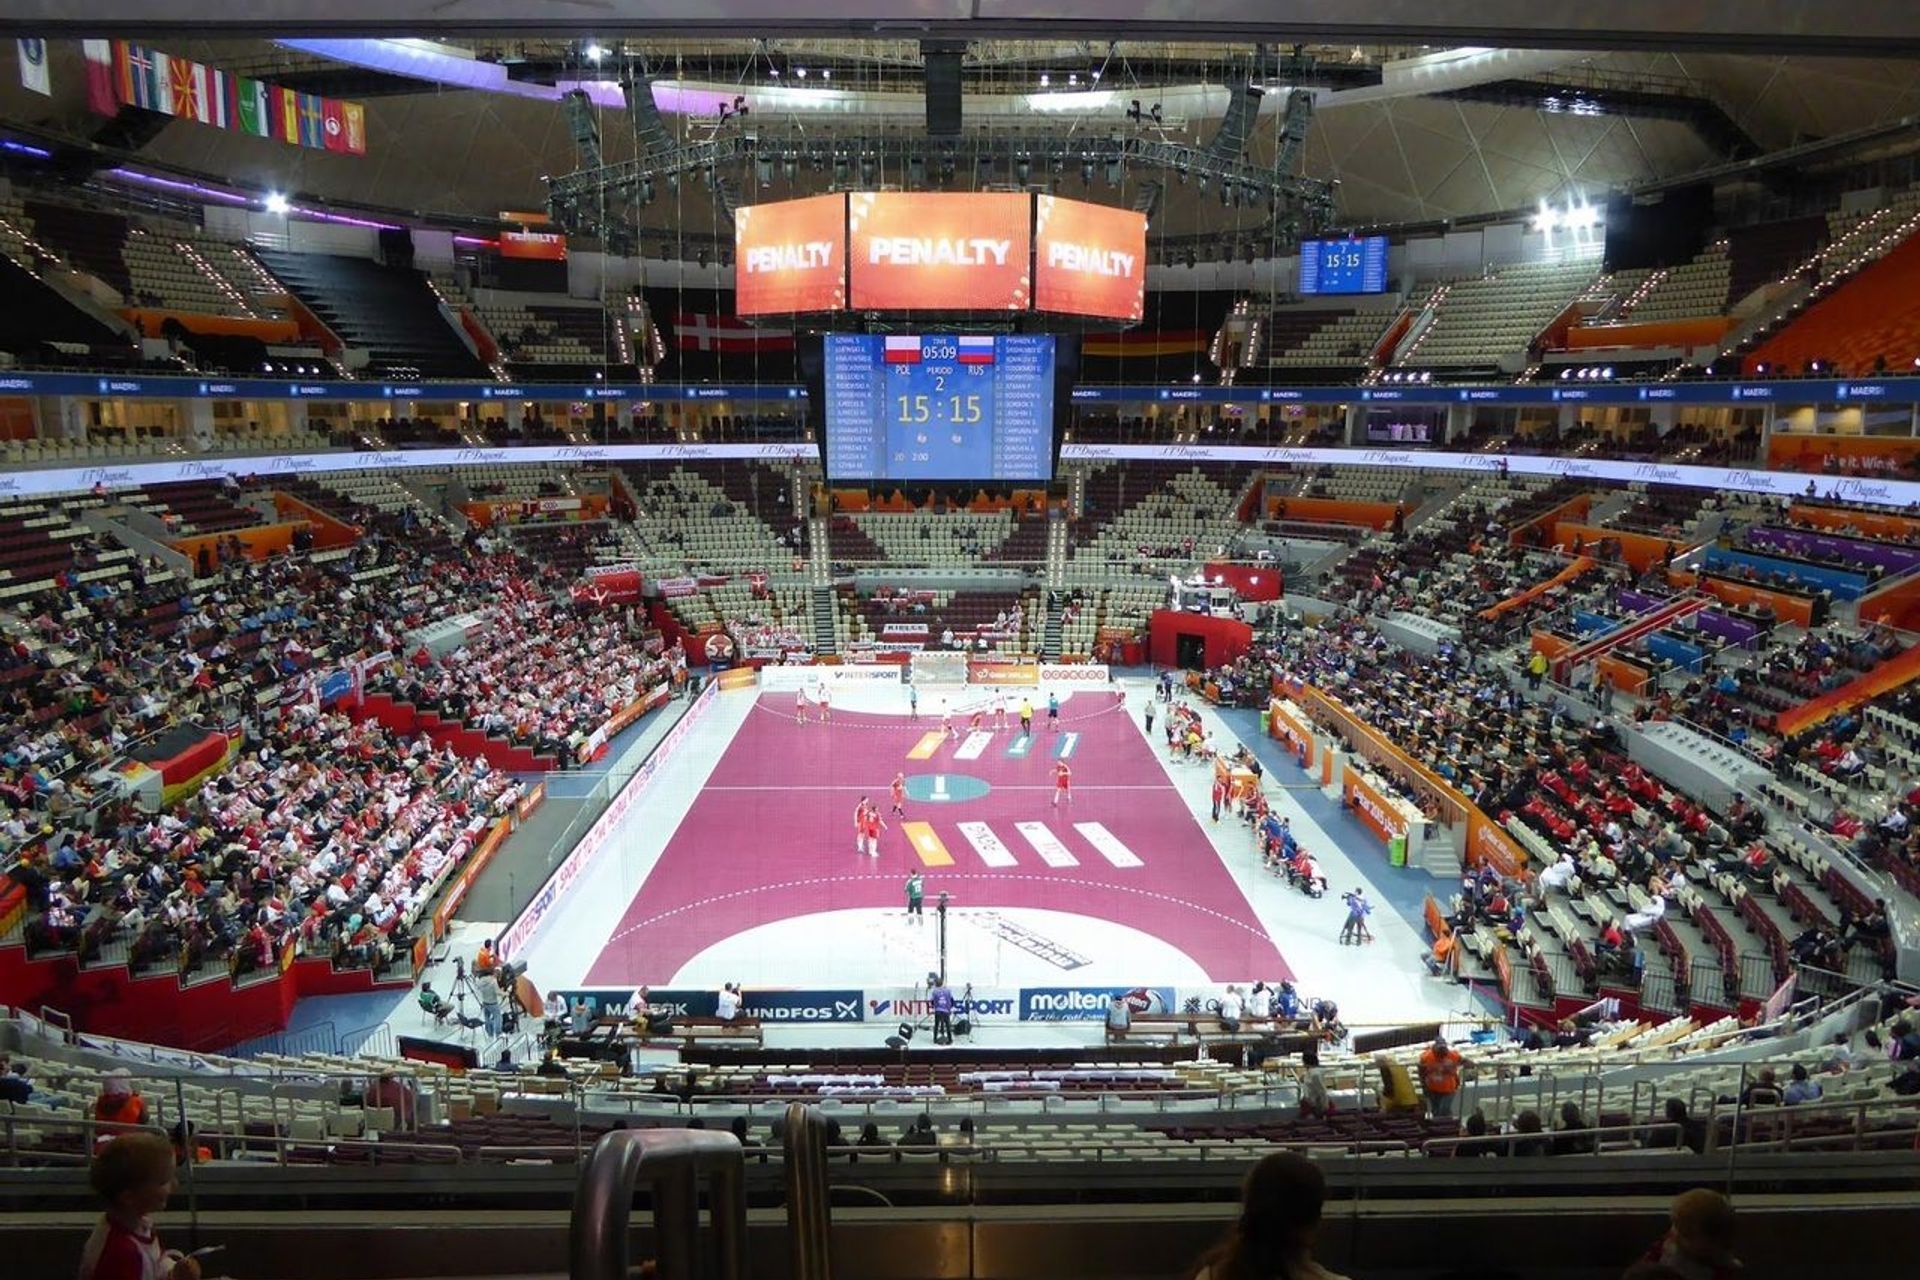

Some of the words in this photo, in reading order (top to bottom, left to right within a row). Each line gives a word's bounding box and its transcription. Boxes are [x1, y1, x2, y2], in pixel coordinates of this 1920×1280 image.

[747, 241, 832, 273] PENALTY
[869, 237, 1010, 266] PENALTY
[1048, 241, 1134, 278] PENALTY
[1326, 254, 1340, 268] 15
[1346, 253, 1360, 267] 15
[922, 346, 956, 360] 05:09
[895, 365, 911, 376] POL
[967, 365, 984, 376] RUS
[936, 376, 944, 391] 2
[898, 395, 930, 422] 15
[950, 395, 981, 422] 15
[845, 671, 899, 680] INTERSPORT
[894, 1000, 1014, 1015] INTESPORT
[1031, 991, 1111, 1010] molten
[744, 1008, 832, 1018] UNDFOS
